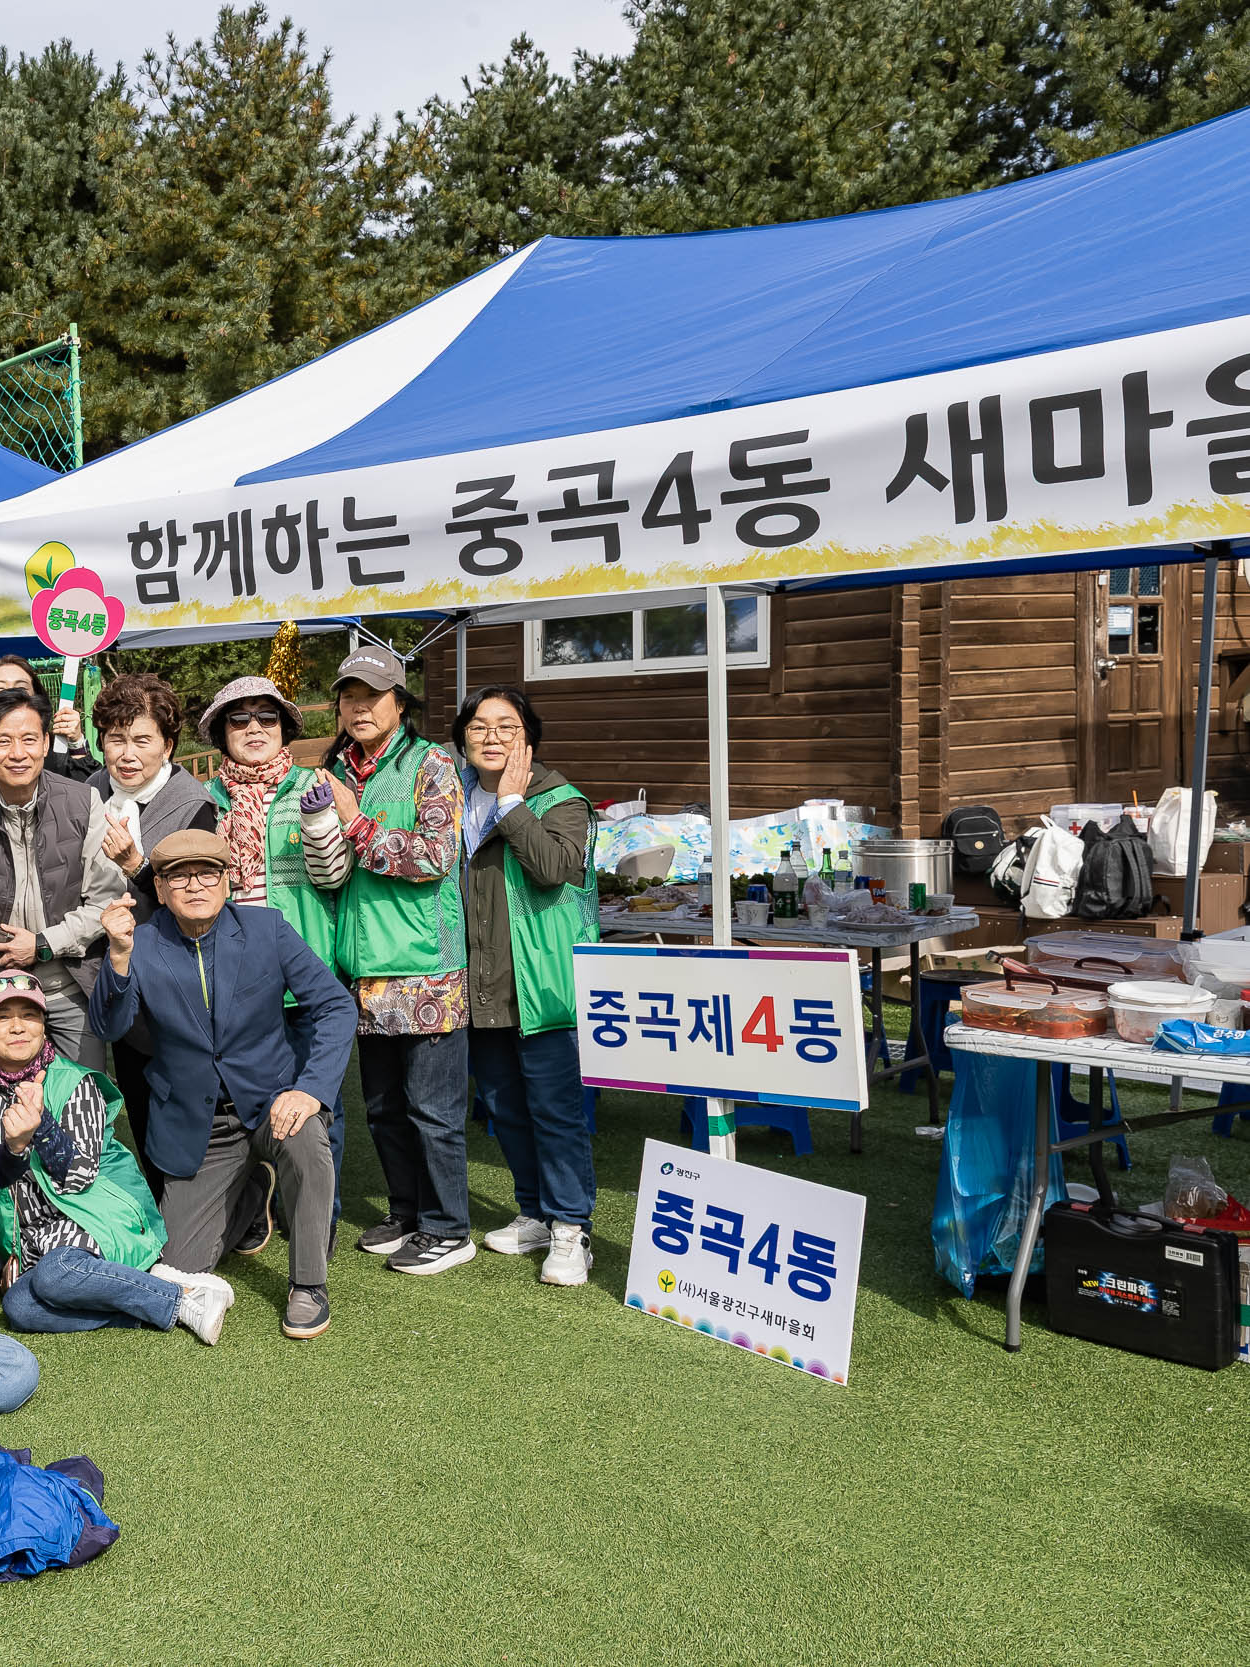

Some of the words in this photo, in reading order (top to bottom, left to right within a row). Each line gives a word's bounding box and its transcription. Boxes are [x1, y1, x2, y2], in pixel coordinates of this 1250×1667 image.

[127, 496, 411, 605] 함께하는
[444, 428, 831, 577] 중곡4동
[48, 607, 107, 637] 중곡4동
[586, 989, 842, 1064] 중곡제4동
[675, 1167, 701, 1181] 광진구
[651, 1189, 838, 1303] 중곡4동
[1082, 1280, 1099, 1288] NEW
[1105, 1277, 1149, 1297] 크린파워
[678, 1279, 816, 1342] (사)서울광진구새마을회
